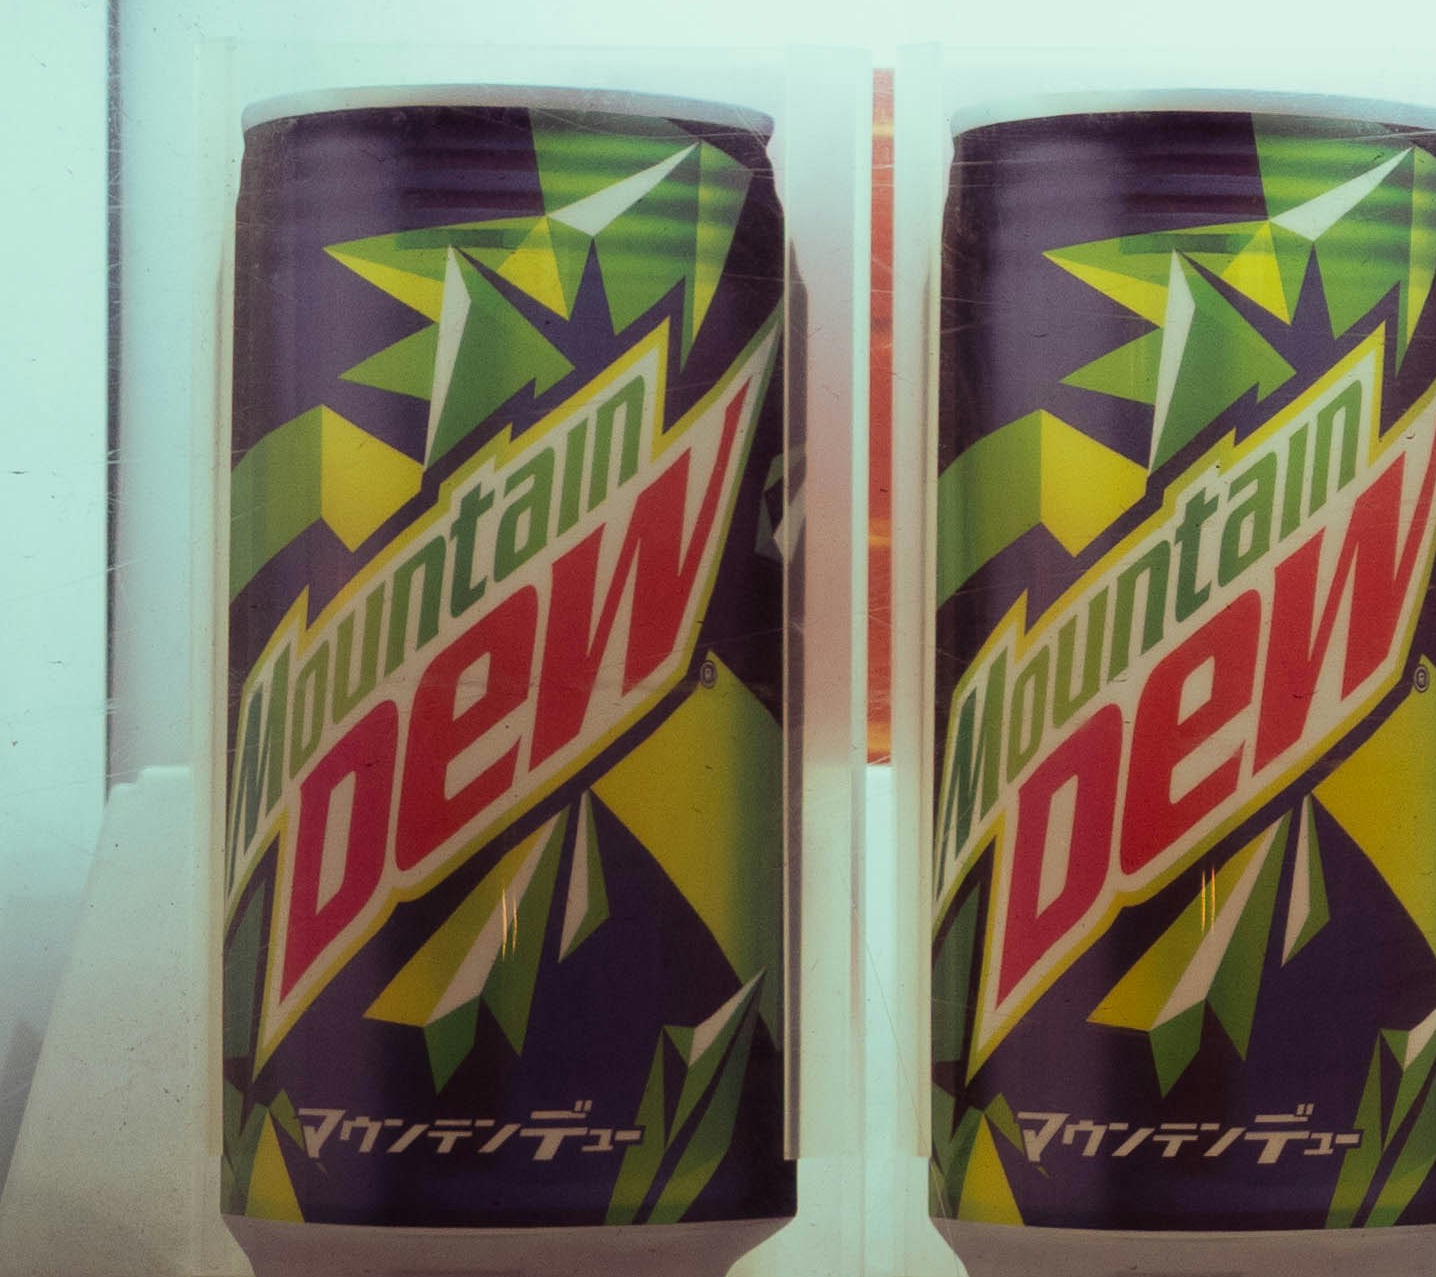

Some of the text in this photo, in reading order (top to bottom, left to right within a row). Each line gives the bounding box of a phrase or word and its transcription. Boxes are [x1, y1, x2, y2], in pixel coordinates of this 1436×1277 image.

[228, 374, 646, 894] Mountain
[936, 380, 1363, 896] Mountain
[299, 1101, 642, 1161] マウンテンデュー
[1017, 1104, 1360, 1165] マウンテンデュー
